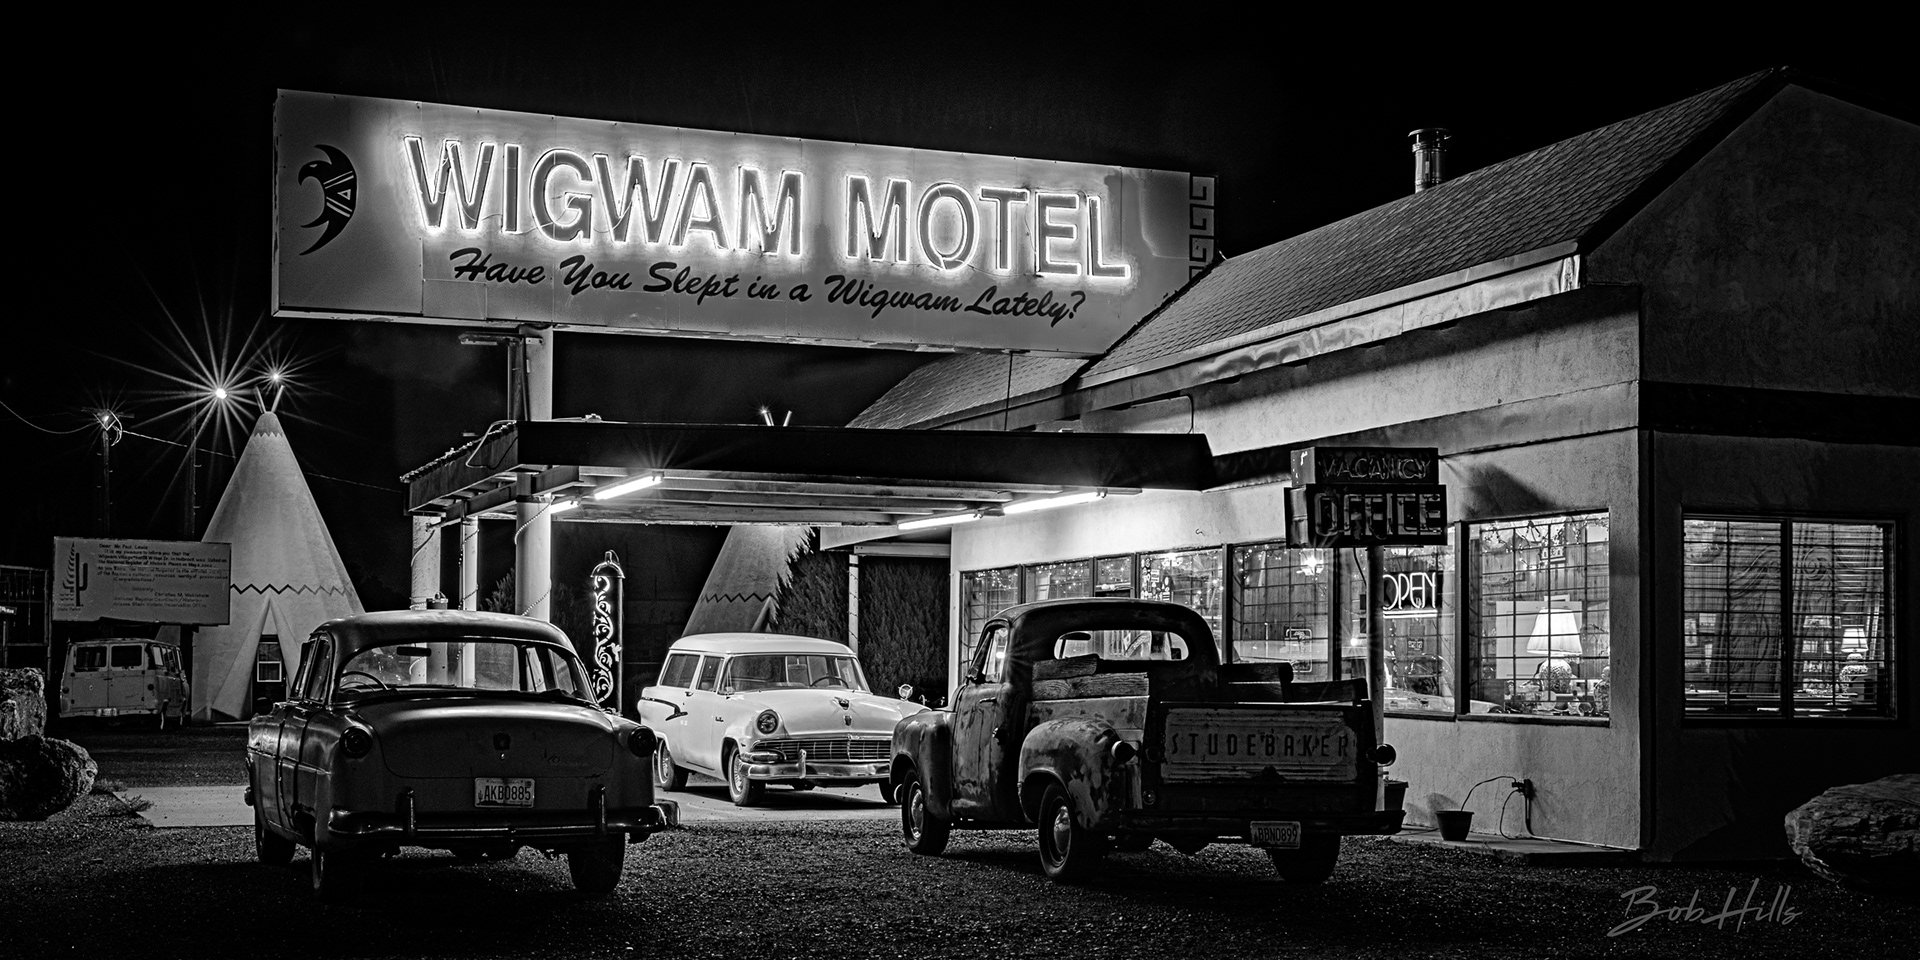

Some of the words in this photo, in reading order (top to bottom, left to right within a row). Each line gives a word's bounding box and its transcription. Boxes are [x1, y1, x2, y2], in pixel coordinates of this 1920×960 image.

[403, 135, 805, 258] WIGWAM
[845, 173, 1132, 280] MOTEL
[449, 247, 546, 285] Have
[559, 254, 633, 296] You
[642, 261, 740, 306] Slept
[747, 275, 782, 300] in
[788, 280, 812, 303] a
[823, 274, 962, 320] Wigwam
[964, 284, 1088, 328] Lately?
[1319, 457, 1431, 480] VACANCY
[1314, 492, 1443, 536] OFFICE
[1383, 571, 1437, 611] OPEN
[1171, 732, 1349, 758] STUDEBAKER
[484, 785, 531, 801] AKB0885
